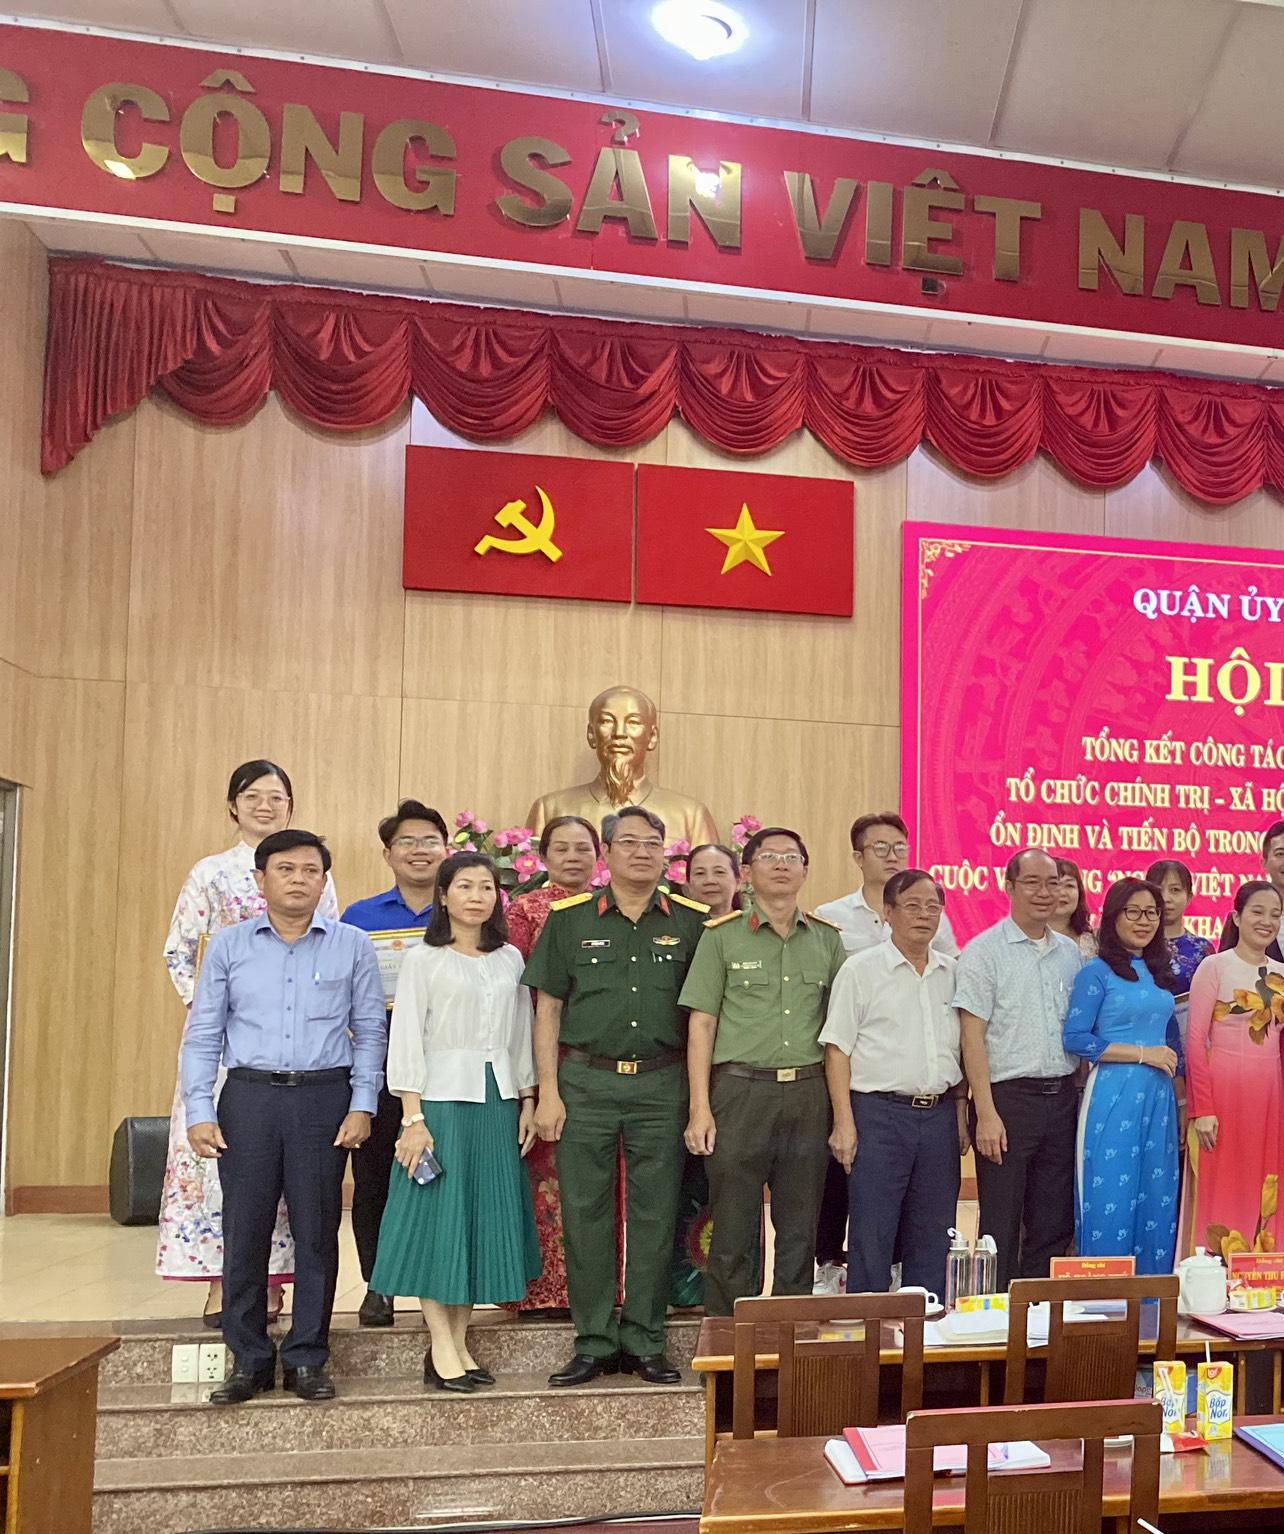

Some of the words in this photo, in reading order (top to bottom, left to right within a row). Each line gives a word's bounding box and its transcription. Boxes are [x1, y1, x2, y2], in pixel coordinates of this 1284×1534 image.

[81, 68, 457, 217] CỘNG
[494, 110, 743, 248] SẢN
[784, 168, 1042, 294] VIỆT
[1133, 585, 1230, 622] QUẬN
[1081, 726, 1139, 763] TỔNG
[1143, 729, 1184, 765] KẾT
[1189, 736, 1245, 768] CÔNG
[1006, 766, 1035, 802] TỔ
[1040, 774, 1099, 805] CHỨC
[1104, 776, 1171, 808] CHÍNH
[1175, 784, 1210, 815] TRỊ
[1229, 780, 1256, 811] XÃ
[989, 811, 1023, 847] ỔN
[1027, 821, 1080, 852] ĐỊNH
[1084, 821, 1114, 849] VÀ
[1118, 816, 1167, 851] TIẾN
[1172, 822, 1201, 858] BỘ
[928, 858, 988, 896] CUỘC
[1192, 866, 1235, 902] VIỆT
[1183, 915, 1223, 939] KHA
